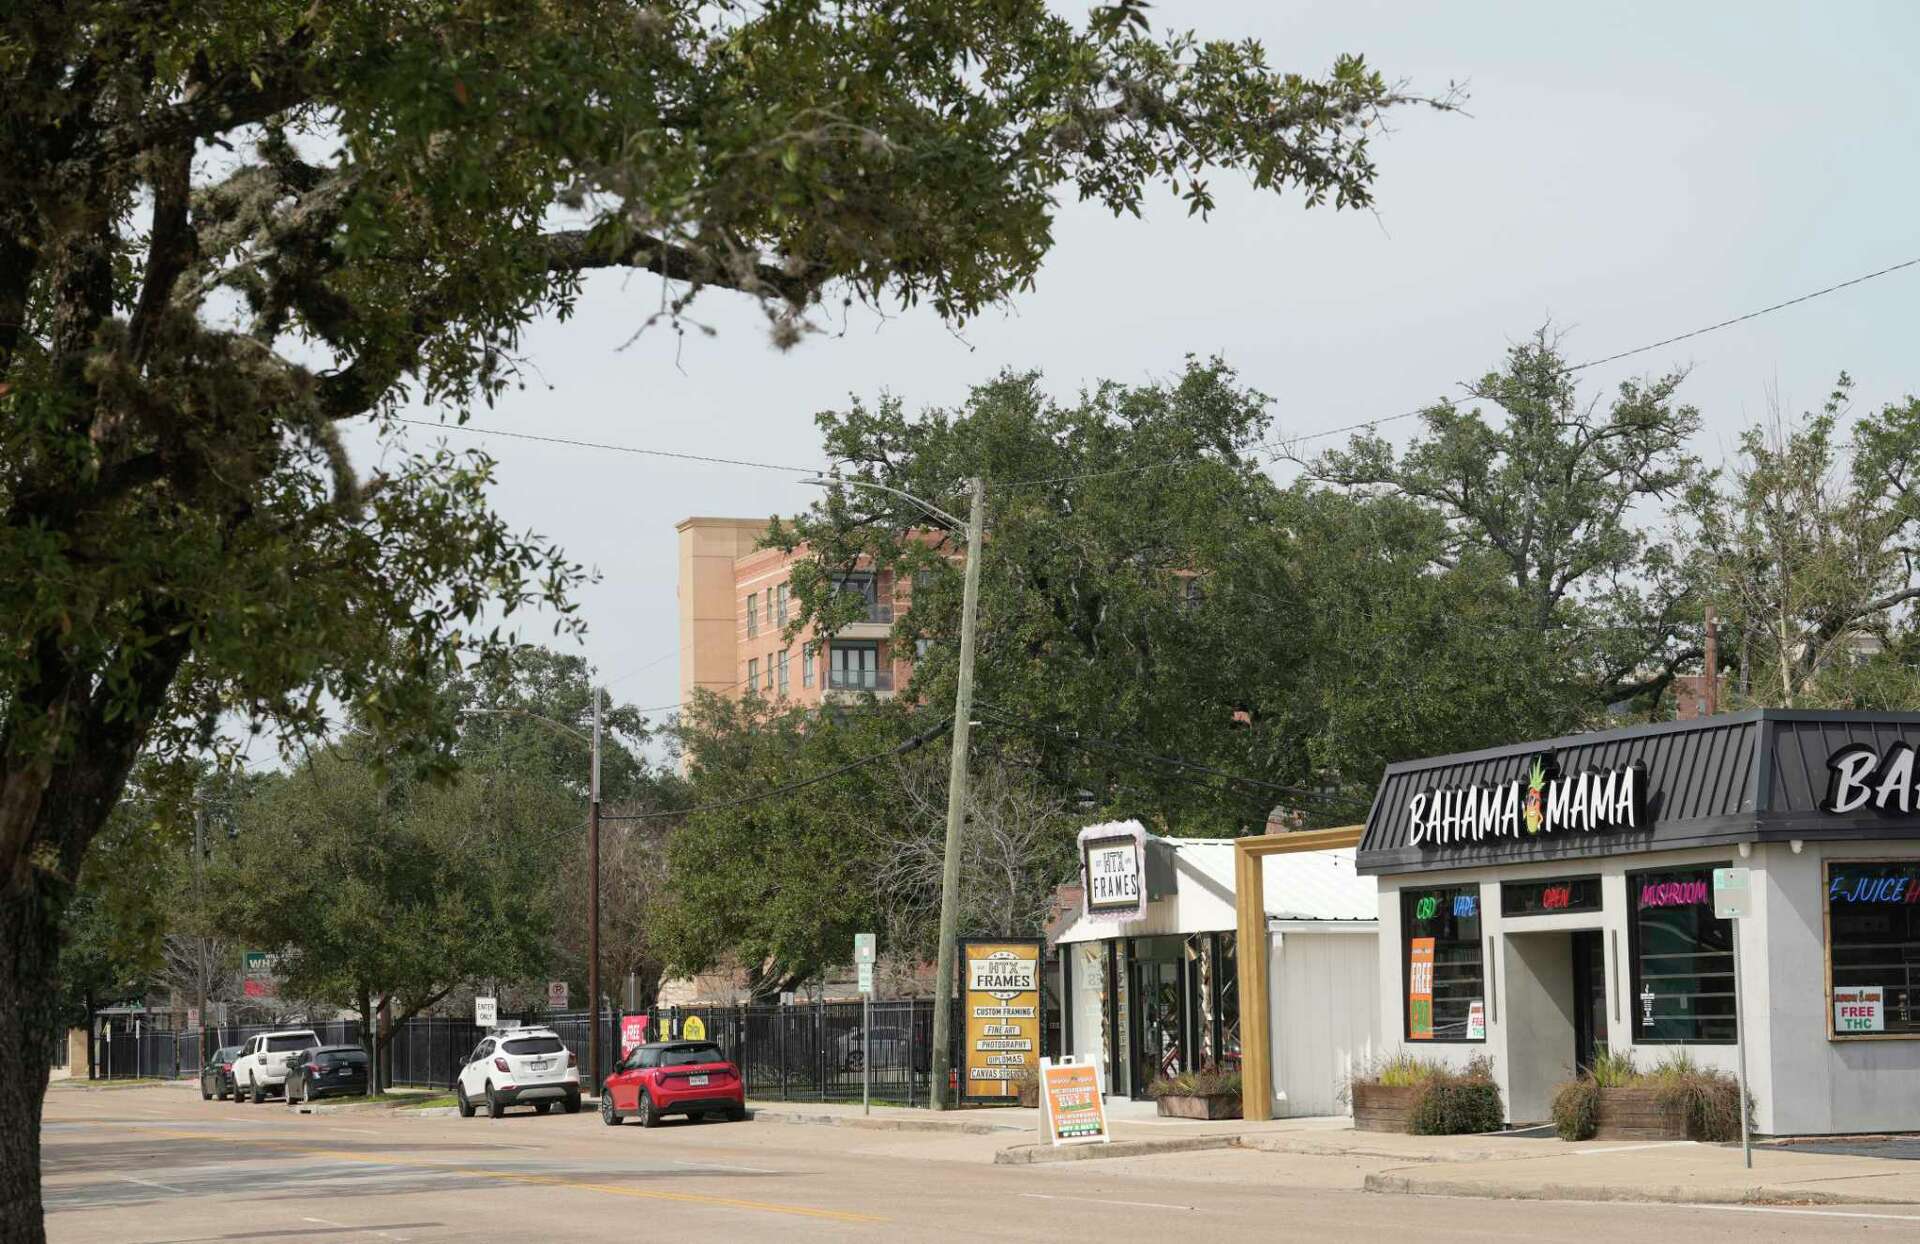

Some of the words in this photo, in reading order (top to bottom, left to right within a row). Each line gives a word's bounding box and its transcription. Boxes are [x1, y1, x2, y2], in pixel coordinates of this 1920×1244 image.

[1830, 749, 1920, 813] BA
[1409, 780, 1519, 846] BAHAMA
[1546, 766, 1635, 832] MAMA
[1094, 874, 1137, 898] FRAMES
[1830, 877, 1908, 902] E-JUICE
[1543, 888, 1569, 908] OPEN
[1641, 882, 1708, 906] MUSHROOM
[1416, 897, 1436, 919] CBD
[1453, 896, 1477, 917] VAPE
[989, 962, 1018, 974] HTX
[977, 975, 1030, 987] FRAMES
[1411, 962, 1433, 994] FREE
[976, 1008, 1001, 1016] CUSTOM
[1003, 1008, 1031, 1016] FRAMING
[1841, 1007, 1874, 1017] FREE
[987, 1025, 1002, 1034] FINE
[1004, 1026, 1016, 1034] ART
[1844, 1018, 1872, 1029] THC
[627, 1025, 640, 1040] FREE
[981, 1040, 1027, 1049] PHOTOGRAPHY
[988, 1055, 1023, 1064] DIPLOMAS
[971, 1069, 997, 1079] CANVAS
